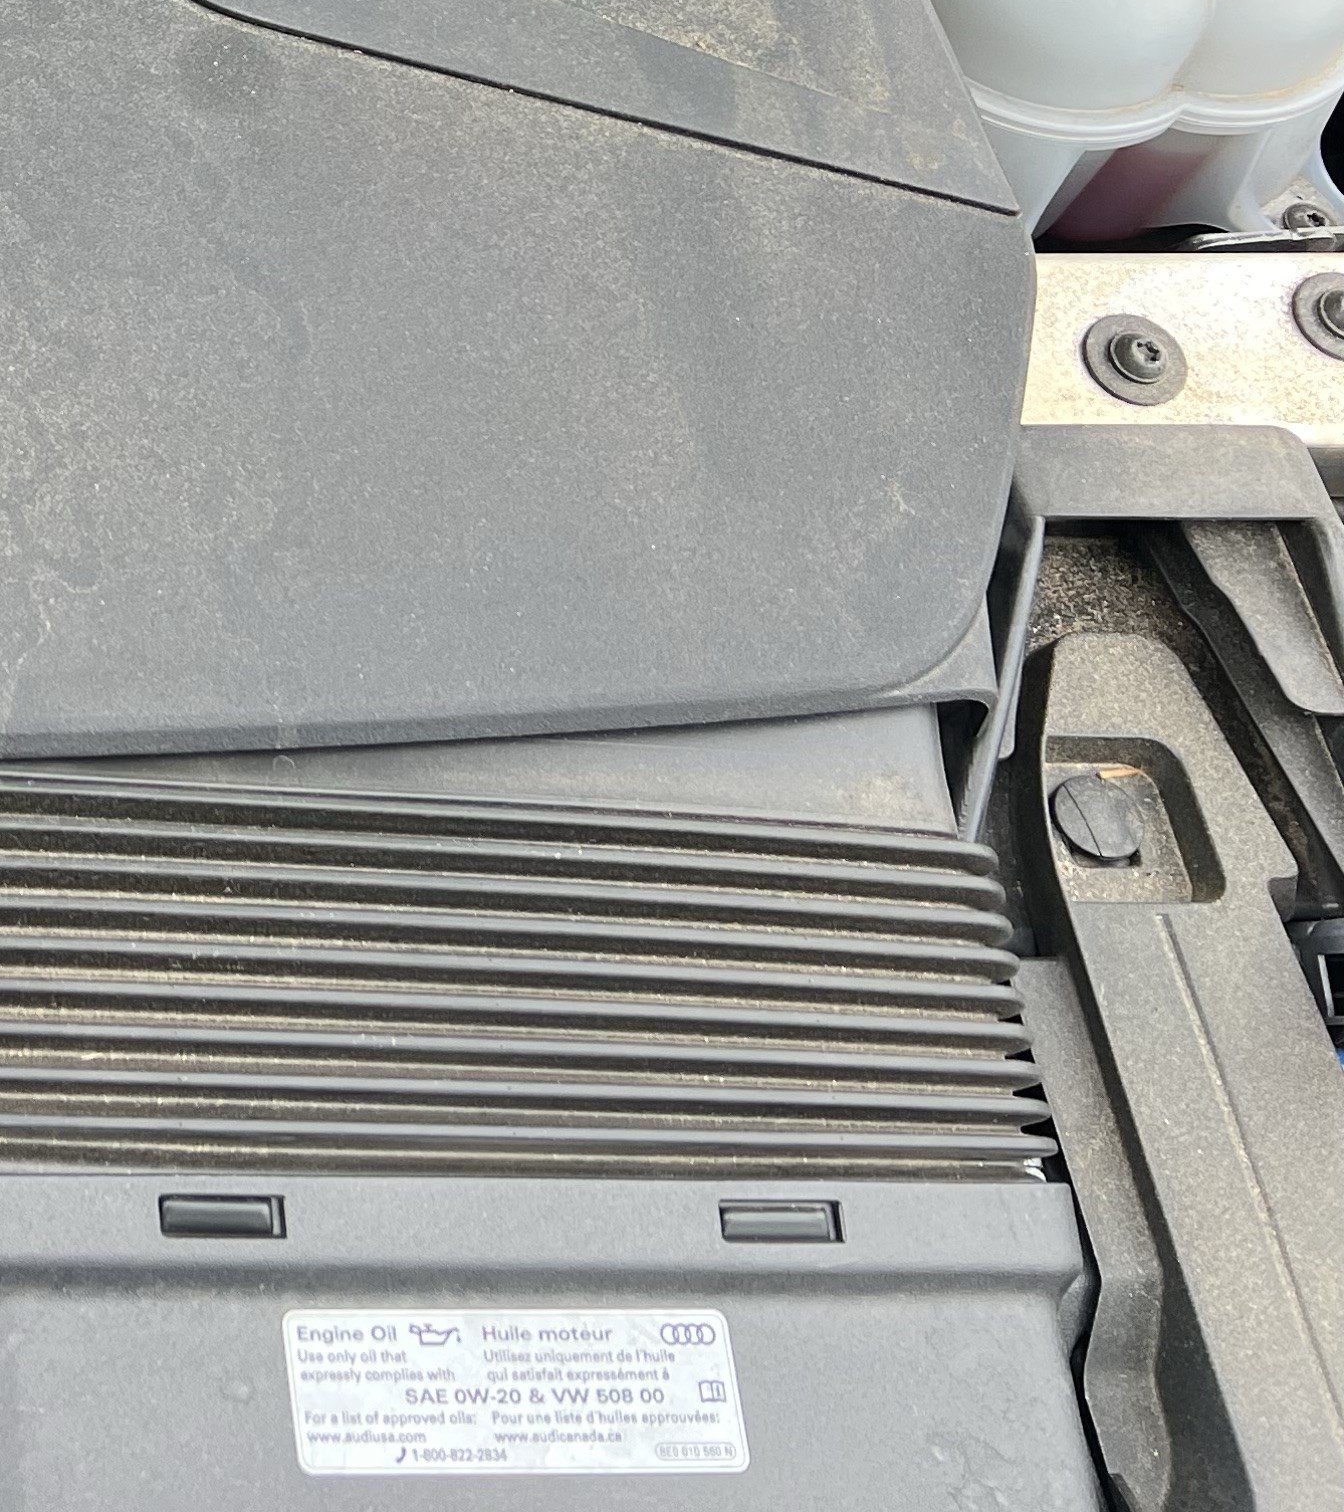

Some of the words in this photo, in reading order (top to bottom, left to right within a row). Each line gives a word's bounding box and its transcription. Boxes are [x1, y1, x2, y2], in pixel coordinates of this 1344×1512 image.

[297, 1325, 363, 1344] Engine
[371, 1324, 397, 1341] Oil
[482, 1326, 532, 1341] Huile
[538, 1327, 613, 1342] moteur
[297, 1350, 324, 1363] Use
[327, 1349, 357, 1365] only
[360, 1349, 377, 1363] oil
[380, 1349, 407, 1363] that
[483, 1349, 531, 1363] Utilisez
[535, 1349, 613, 1366] uniquement
[617, 1349, 633, 1363] de
[636, 1349, 675, 1363] l'huile
[300, 1368, 361, 1384] expressly
[365, 1368, 423, 1383] complies
[427, 1368, 456, 1381] with
[487, 1368, 508, 1384] qui
[512, 1367, 563, 1381] satisfait
[566, 1367, 658, 1383] expressément
[405, 1388, 448, 1404] SAE
[455, 1388, 522, 1404] 0W-20
[529, 1388, 544, 1404] &
[551, 1388, 589, 1404] VW
[597, 1388, 634, 1404] 508
[640, 1388, 665, 1404] 00
[304, 1411, 326, 1424] For
[330, 1414, 339, 1424] a
[342, 1411, 362, 1424] list
[365, 1411, 379, 1424] of
[383, 1411, 445, 1427] approved
[449, 1411, 477, 1424] oils:
[492, 1411, 523, 1425] Pour
[527, 1413, 551, 1425] une
[555, 1411, 582, 1424] liste
[307, 1430, 427, 1443] www.audiusa.com
[494, 1430, 623, 1443] www.audicanada.ca
[412, 1448, 508, 1462] 1-800-822-2834
